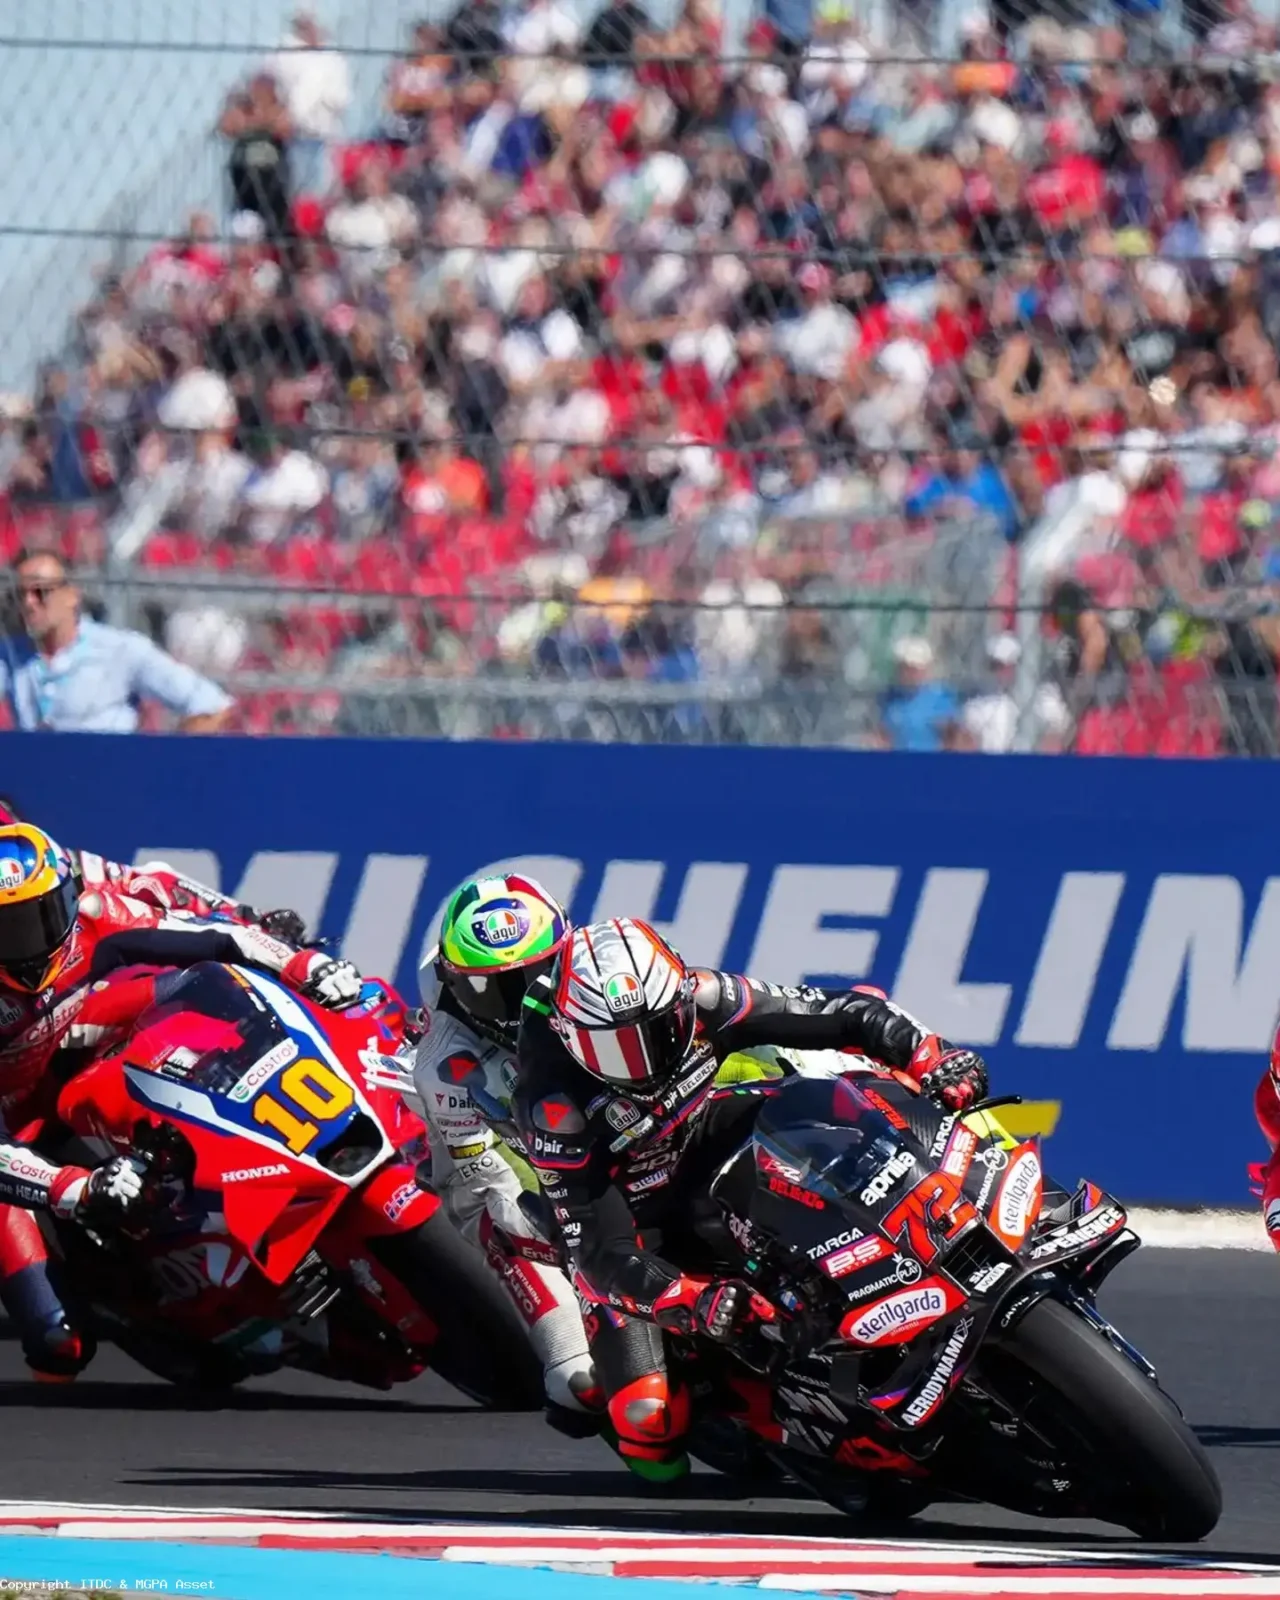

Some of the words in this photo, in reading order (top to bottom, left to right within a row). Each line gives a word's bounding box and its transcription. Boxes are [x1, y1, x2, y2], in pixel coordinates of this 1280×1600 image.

[253, 1056, 356, 1157] 10
[929, 1113, 958, 1158] TARGA
[221, 1163, 291, 1183] HONDA
[860, 1150, 917, 1206] aprilia
[1004, 1160, 1038, 1231] sterilgarda
[878, 1170, 979, 1268] 72
[806, 1227, 865, 1261] TARGA
[825, 1237, 882, 1274] BS
[848, 1274, 899, 1301] PRAGMATIC
[899, 1264, 920, 1281] PLAY
[969, 1262, 993, 1284] sky
[857, 1290, 942, 1341] sterilgarda
